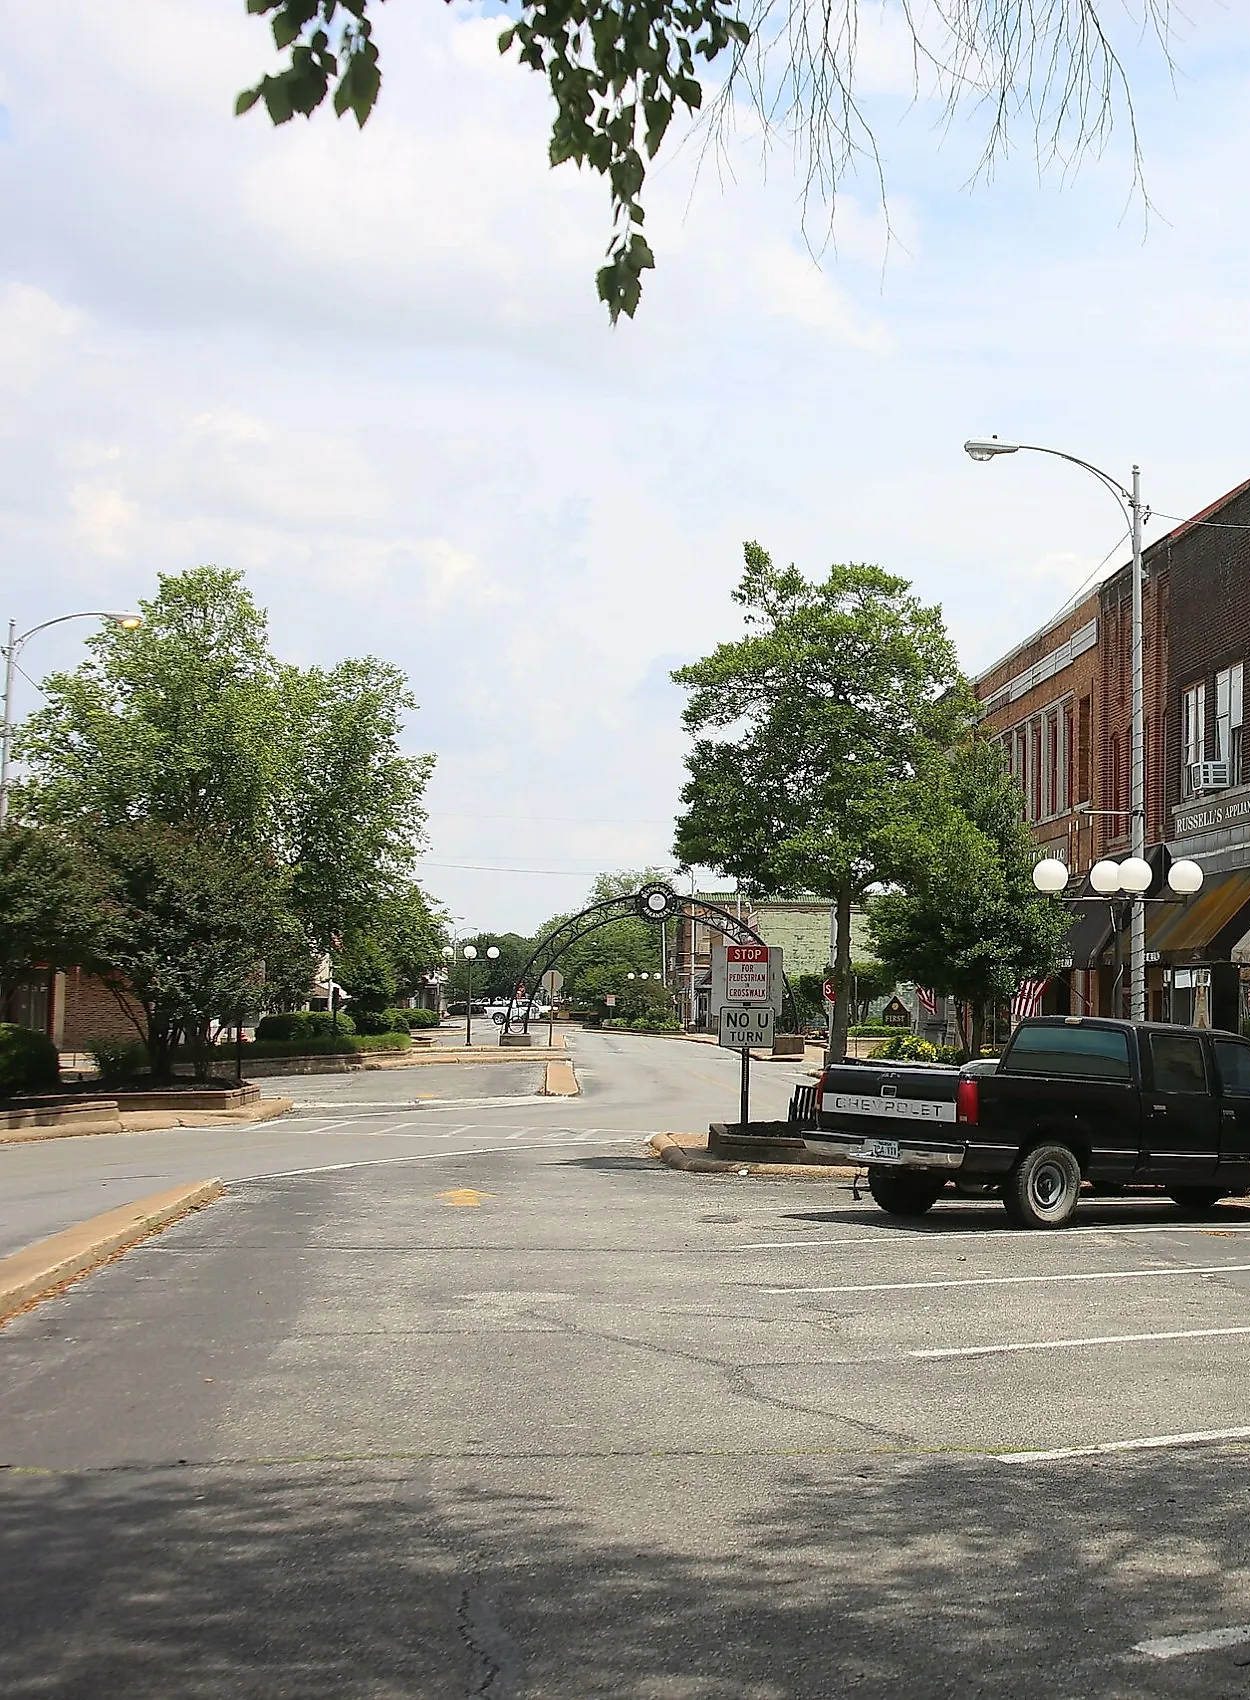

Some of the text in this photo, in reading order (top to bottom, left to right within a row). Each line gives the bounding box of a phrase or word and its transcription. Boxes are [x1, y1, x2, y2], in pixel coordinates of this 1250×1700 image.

[1176, 808, 1222, 834] RUSSELL'S
[734, 949, 762, 960] STOP
[741, 964, 754, 973] FOR
[728, 973, 766, 982] PEDESTRIAN
[729, 988, 766, 998] CROSSWALK
[726, 1012, 769, 1029] NO U
[885, 1015, 905, 1023] FIRST
[729, 1031, 763, 1042] TURN
[835, 1096, 943, 1117] CHEVROLET
